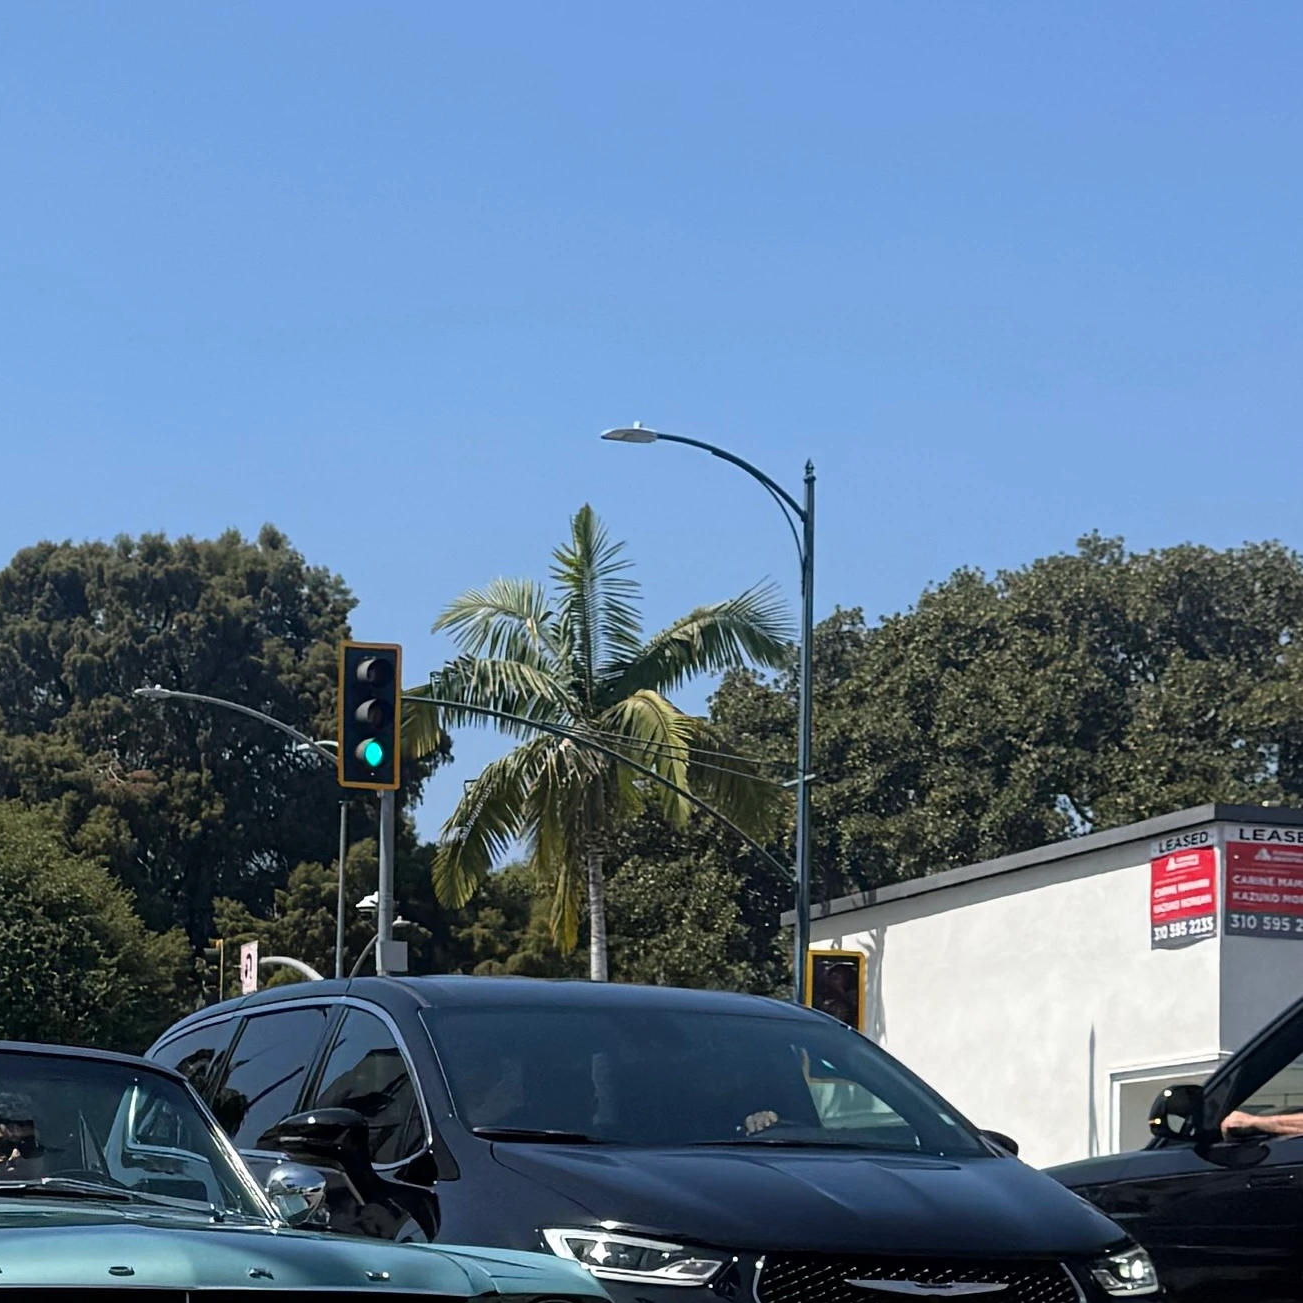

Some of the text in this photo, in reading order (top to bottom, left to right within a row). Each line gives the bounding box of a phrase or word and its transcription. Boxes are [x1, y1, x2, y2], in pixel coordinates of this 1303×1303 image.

[1159, 831, 1208, 853] LEASED
[1231, 914, 1257, 929] 310
[1262, 916, 1290, 931] 595
